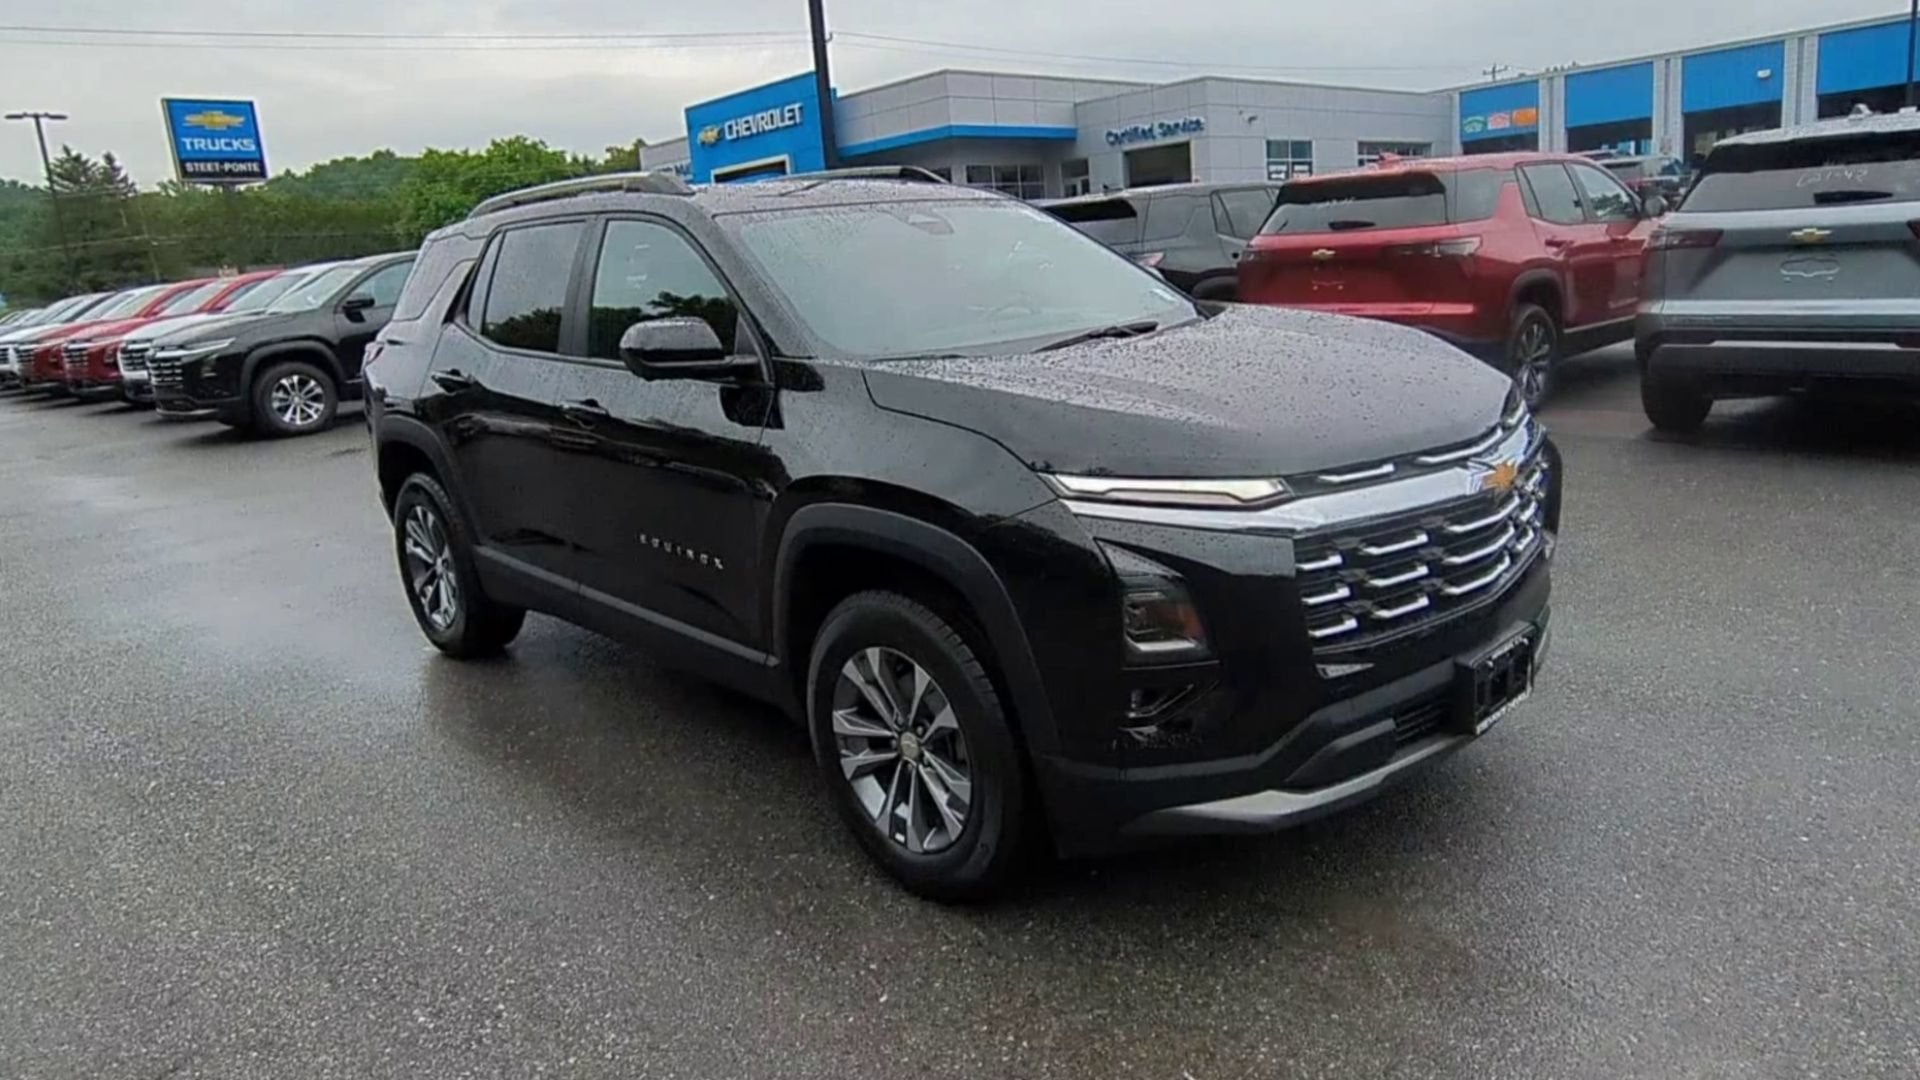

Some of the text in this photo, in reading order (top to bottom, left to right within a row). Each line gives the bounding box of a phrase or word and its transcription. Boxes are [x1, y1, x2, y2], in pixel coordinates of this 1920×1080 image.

[724, 103, 803, 140] CHEVROLET
[1105, 117, 1205, 146] Certified Service
[181, 137, 256, 151] TRUCKS
[185, 162, 260, 172] STEET-PONTE
